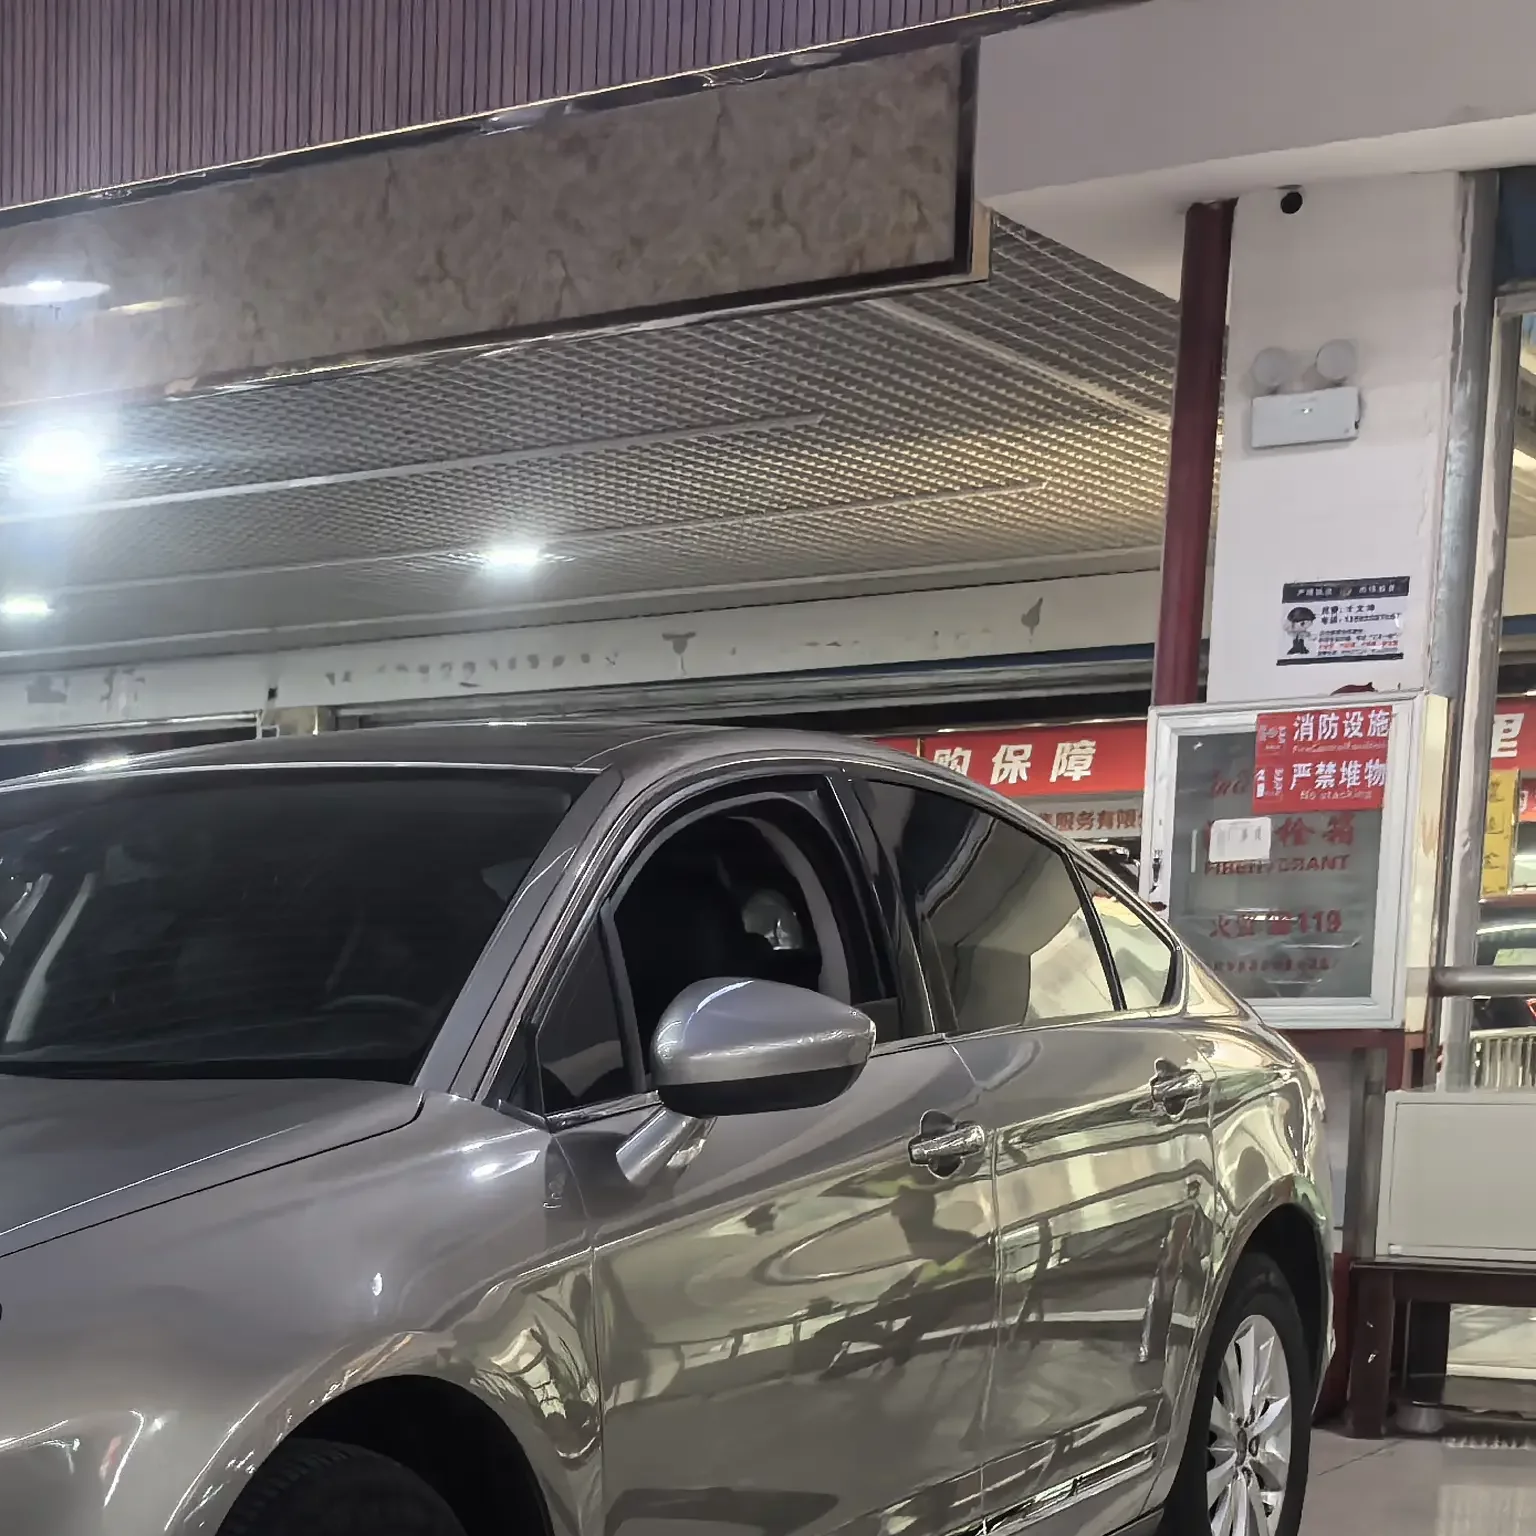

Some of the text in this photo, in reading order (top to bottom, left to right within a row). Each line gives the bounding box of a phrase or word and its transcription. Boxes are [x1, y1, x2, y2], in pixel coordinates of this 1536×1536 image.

[1292, 709, 1391, 742] 消防设施
[933, 739, 1097, 785] 购保障
[1289, 758, 1388, 791] 严禁堆物
[1041, 808, 1142, 833] 服务有限
